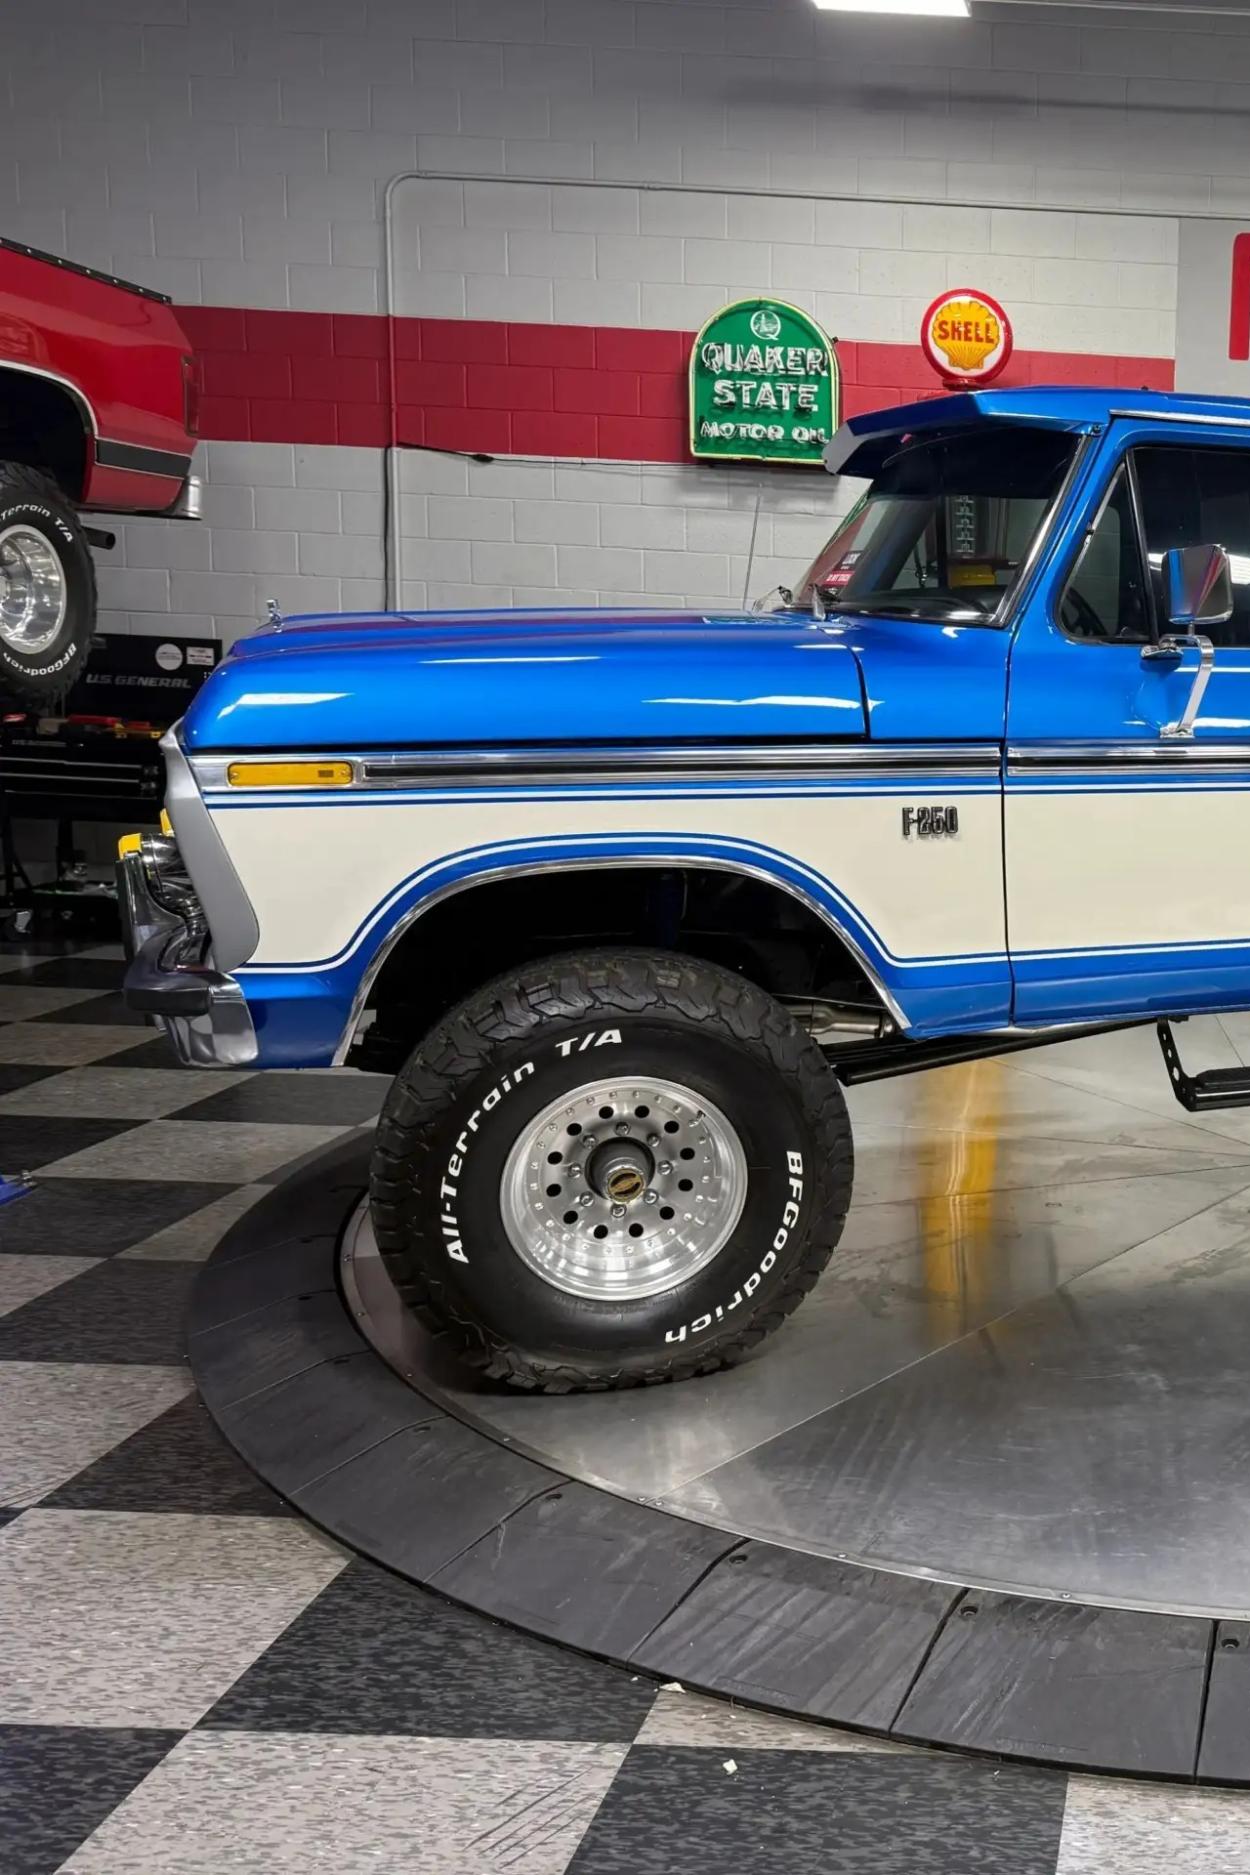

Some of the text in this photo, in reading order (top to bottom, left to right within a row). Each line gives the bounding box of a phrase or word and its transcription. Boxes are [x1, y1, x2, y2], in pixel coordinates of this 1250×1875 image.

[937, 319, 995, 344] SHELL
[701, 342, 828, 376] QUAKER
[713, 379, 818, 411] STATE
[700, 420, 785, 441] MOTOR
[54, 517, 73, 542] T/A
[3, 642, 77, 677] BFGoodrich
[114, 675, 192, 689] GENERAL
[440, 1028, 623, 1265] All-Terrain T/A
[663, 1150, 804, 1345] BFGoodrich
